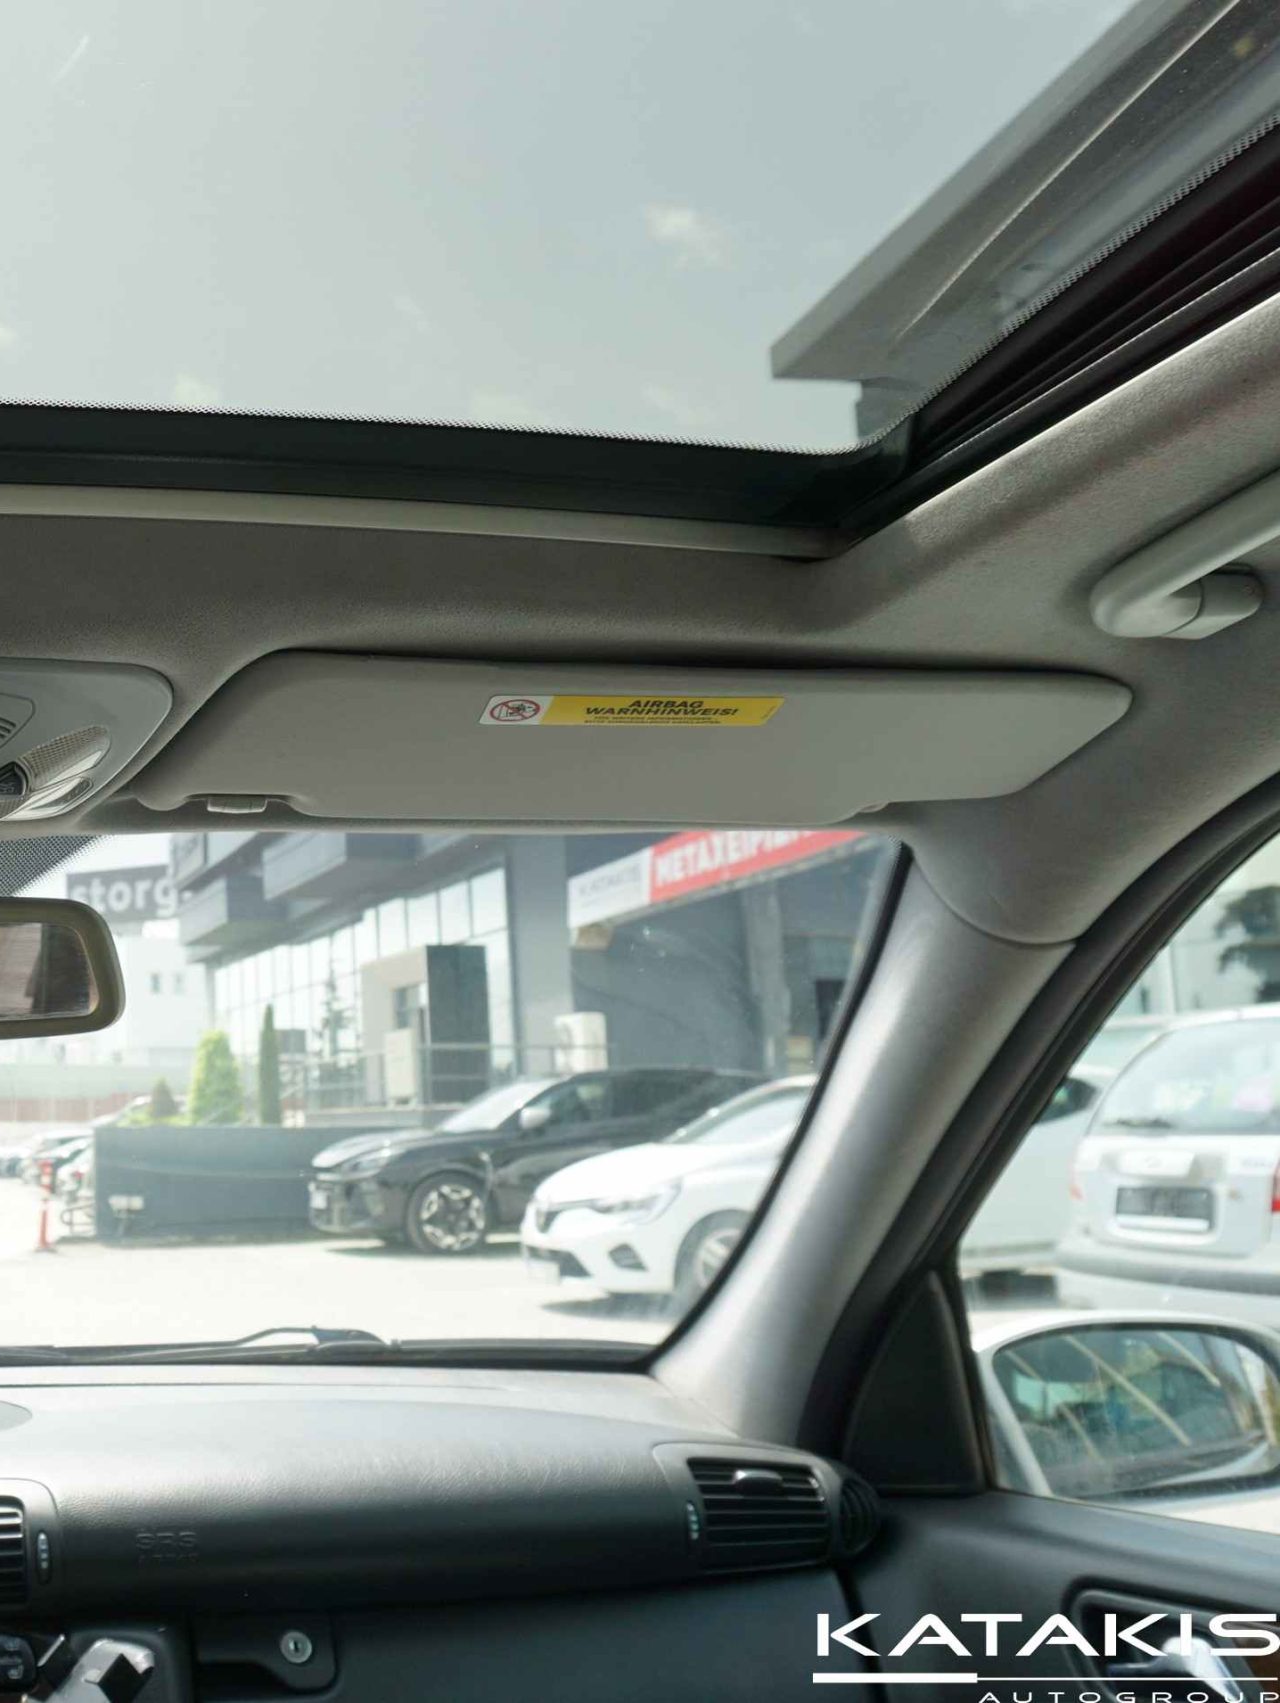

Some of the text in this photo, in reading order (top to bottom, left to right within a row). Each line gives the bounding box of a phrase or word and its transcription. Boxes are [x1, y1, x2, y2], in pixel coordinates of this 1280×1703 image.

[628, 699, 705, 708] AIRBAG
[584, 706, 739, 716] WARNHINWEIS!
[71, 877, 193, 918] storg
